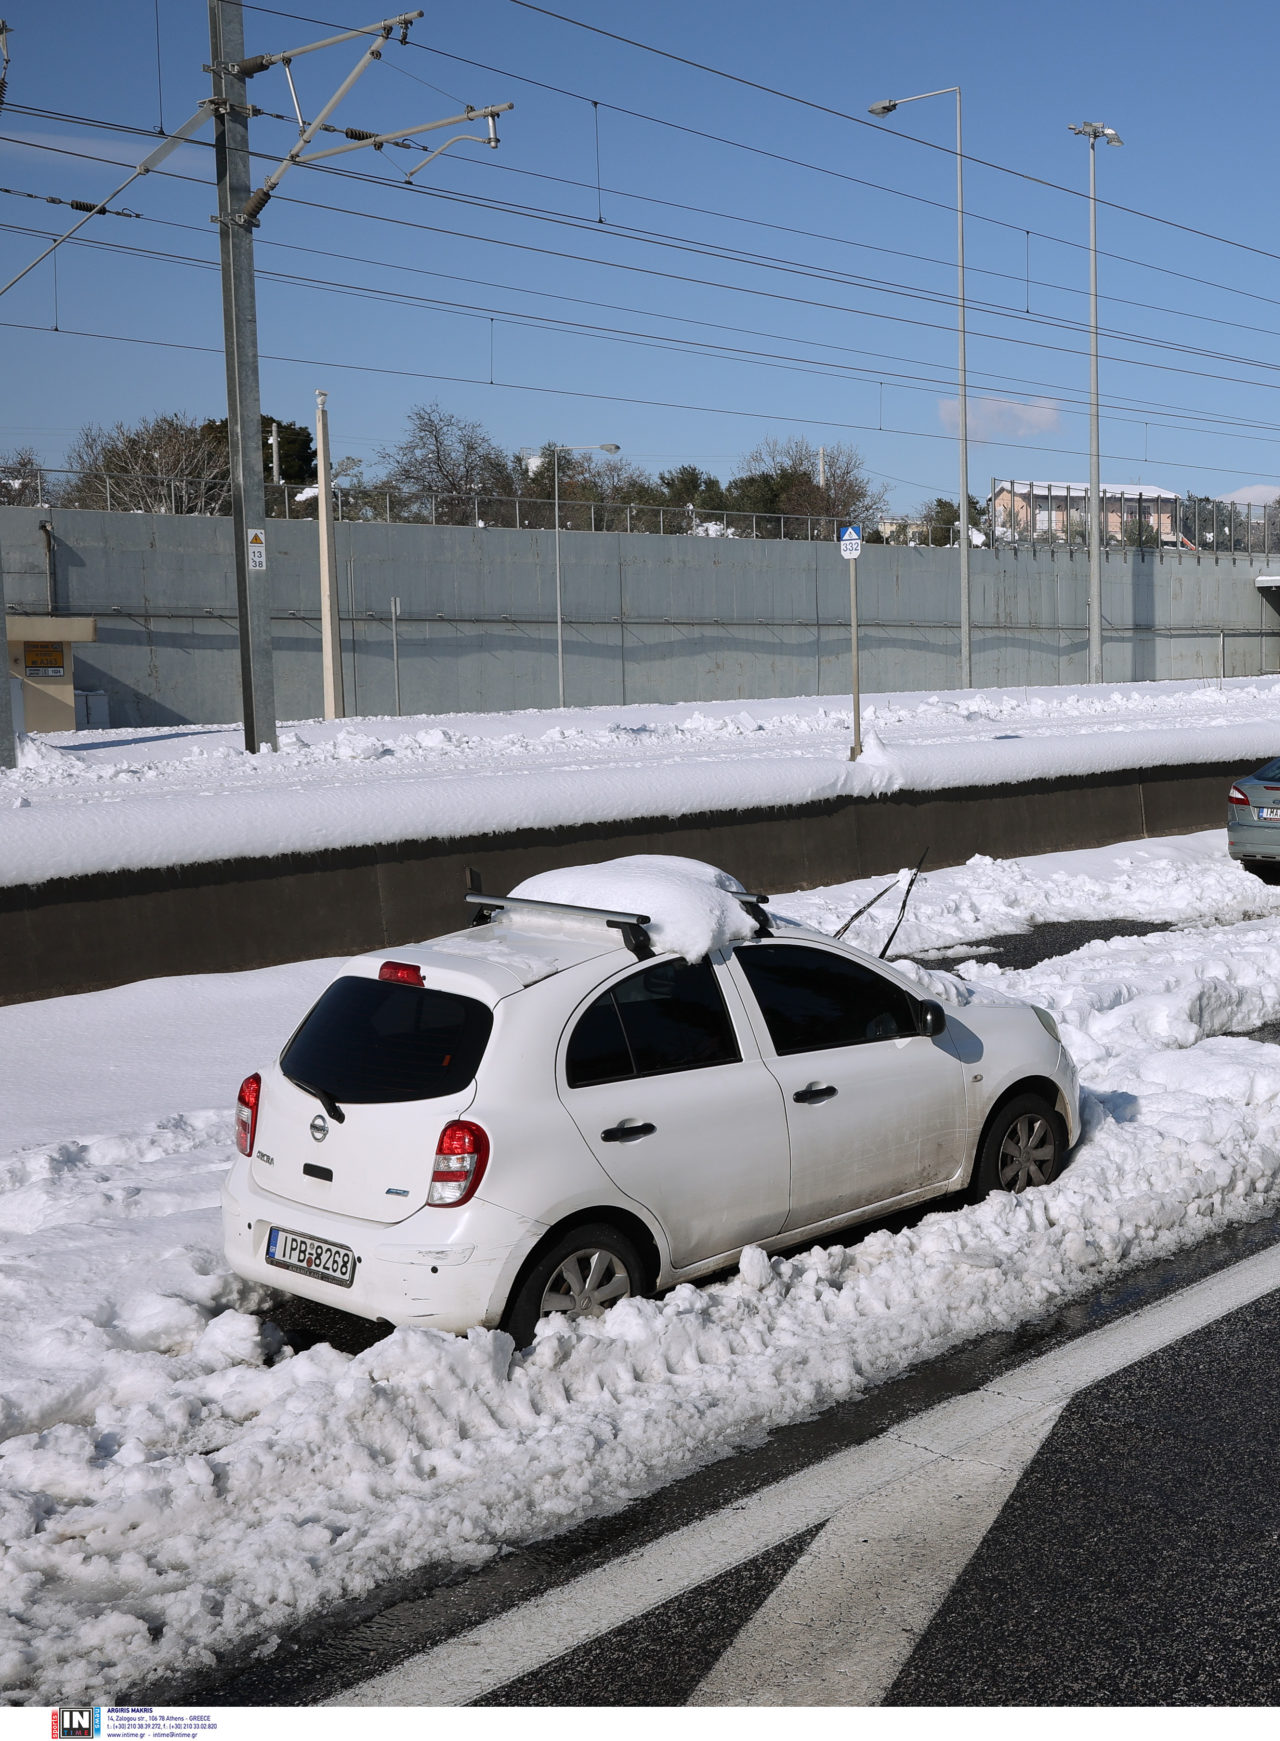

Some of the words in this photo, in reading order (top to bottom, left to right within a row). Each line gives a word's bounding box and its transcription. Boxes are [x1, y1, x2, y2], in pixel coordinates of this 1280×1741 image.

[842, 542, 860, 552] 332
[252, 550, 263, 559] 13
[252, 560, 264, 568] 38
